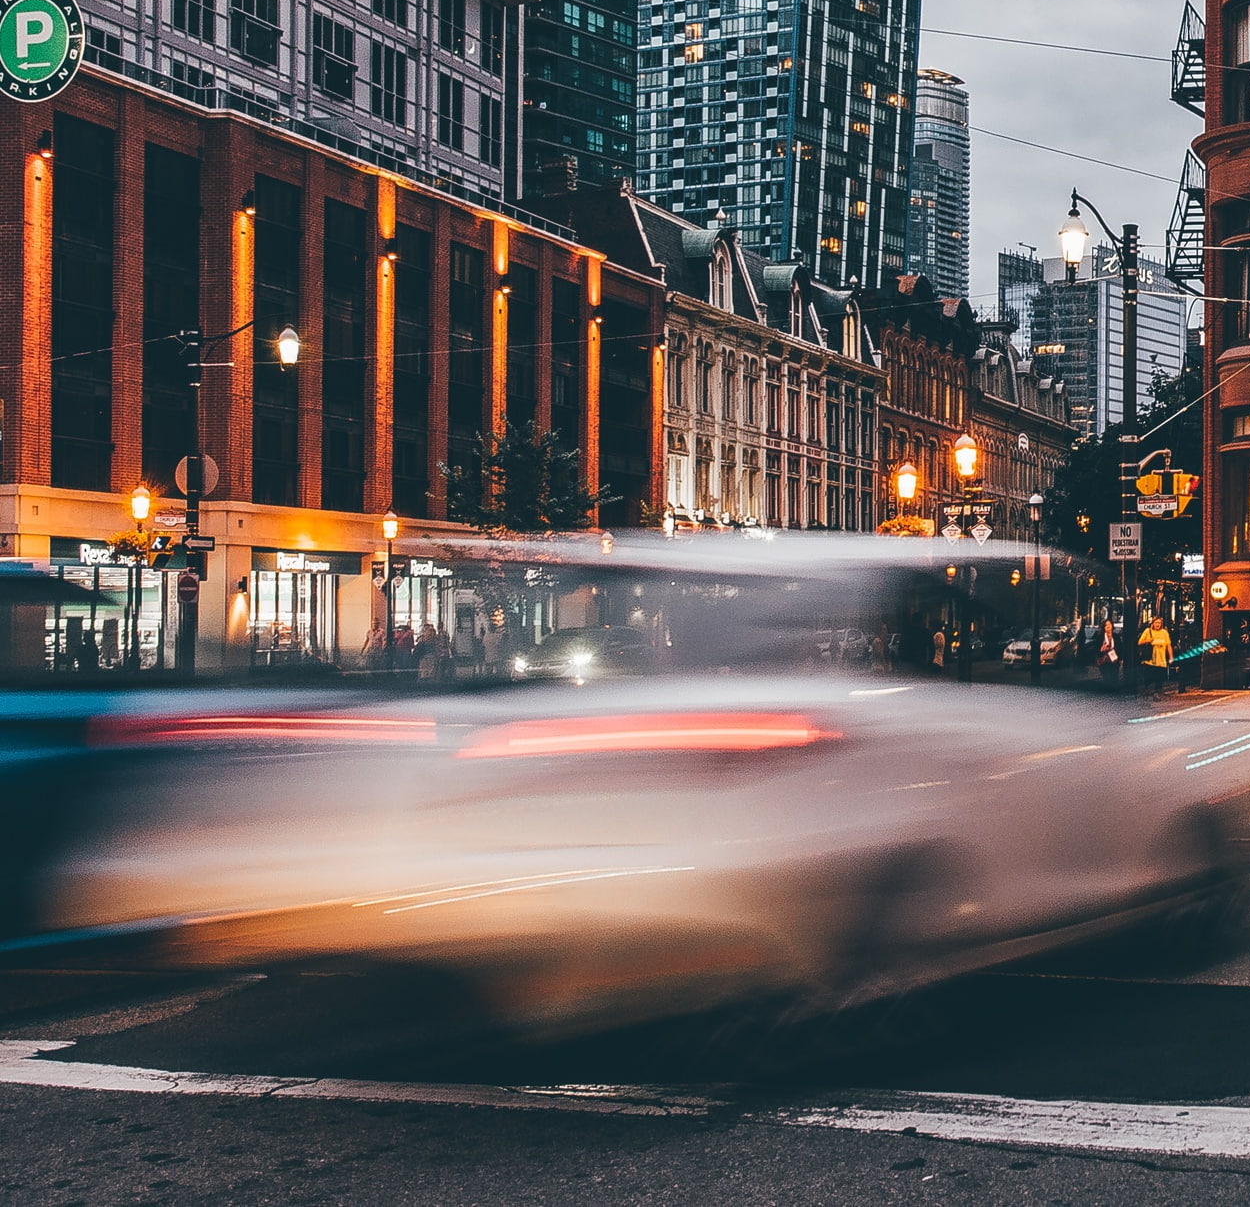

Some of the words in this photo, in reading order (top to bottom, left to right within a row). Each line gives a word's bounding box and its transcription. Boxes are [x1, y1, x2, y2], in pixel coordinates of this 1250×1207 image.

[15, 10, 54, 58] P
[1120, 526, 1132, 537] NO
[1112, 539, 1138, 547] PEDESTRIAN
[276, 551, 305, 571] Rexall
[410, 559, 433, 577] Rexall
